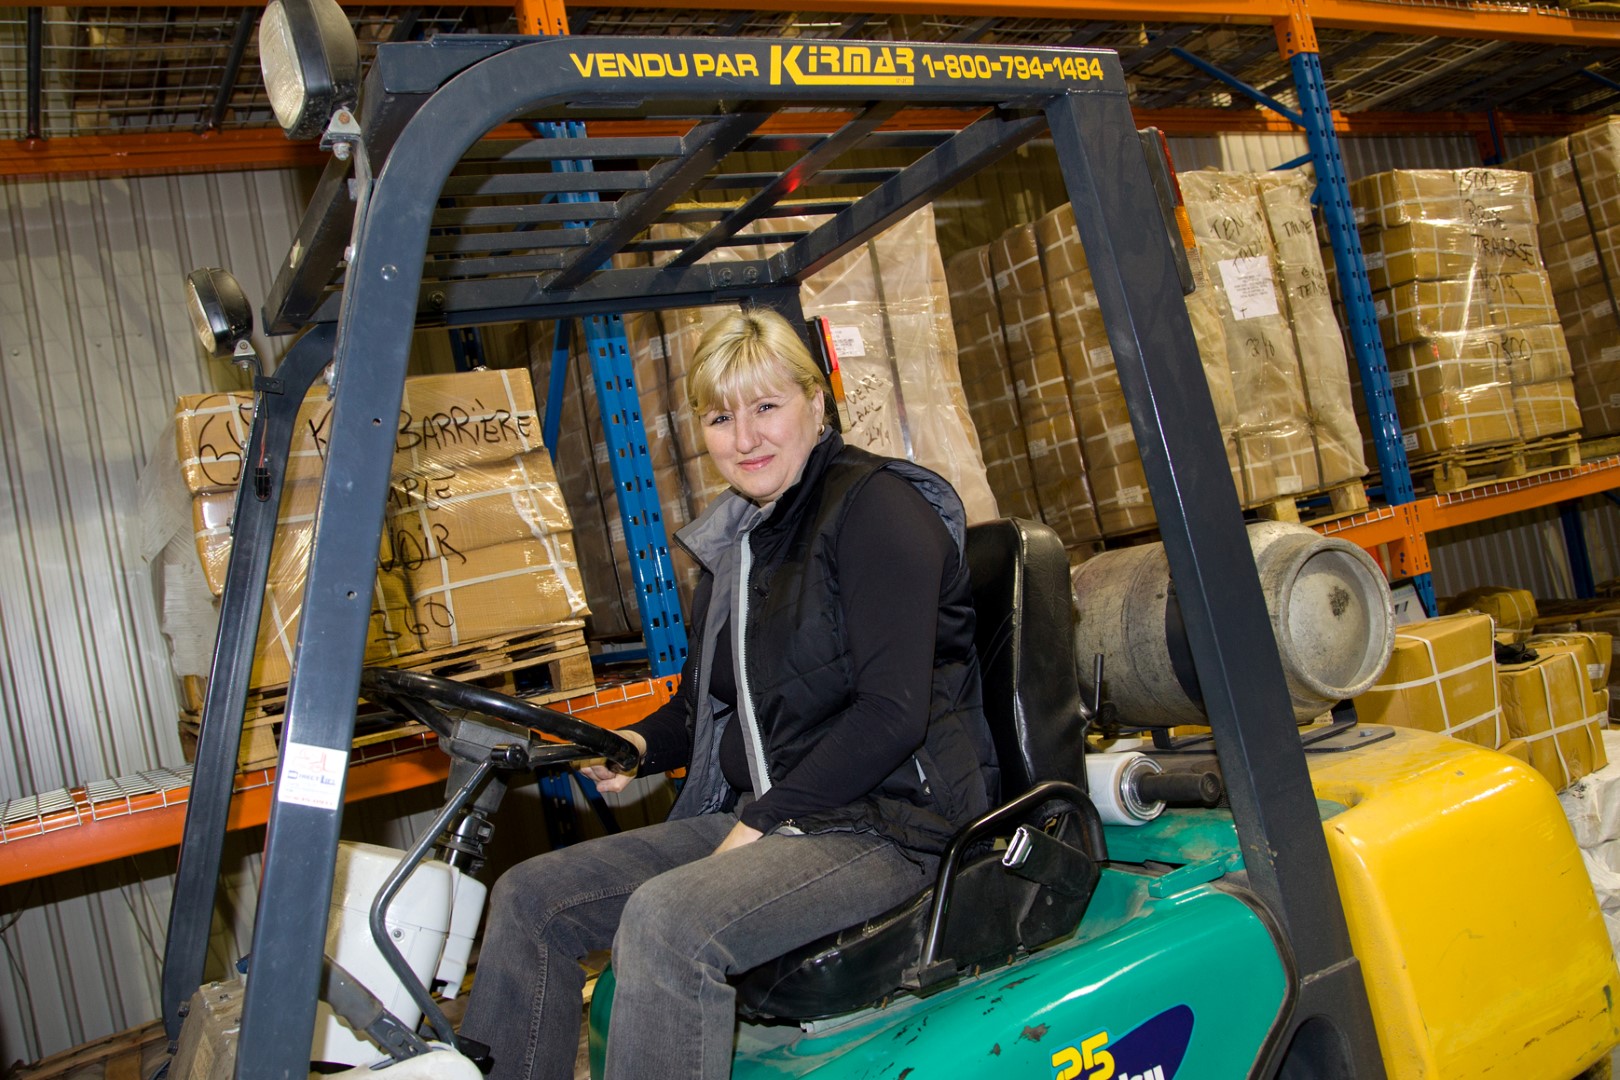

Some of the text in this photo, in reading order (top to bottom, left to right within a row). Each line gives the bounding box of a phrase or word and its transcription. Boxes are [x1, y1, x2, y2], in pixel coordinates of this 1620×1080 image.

[569, 52, 688, 79] VENDU
[696, 54, 759, 78] PAR
[922, 56, 1104, 81] 1-800-794-1484
